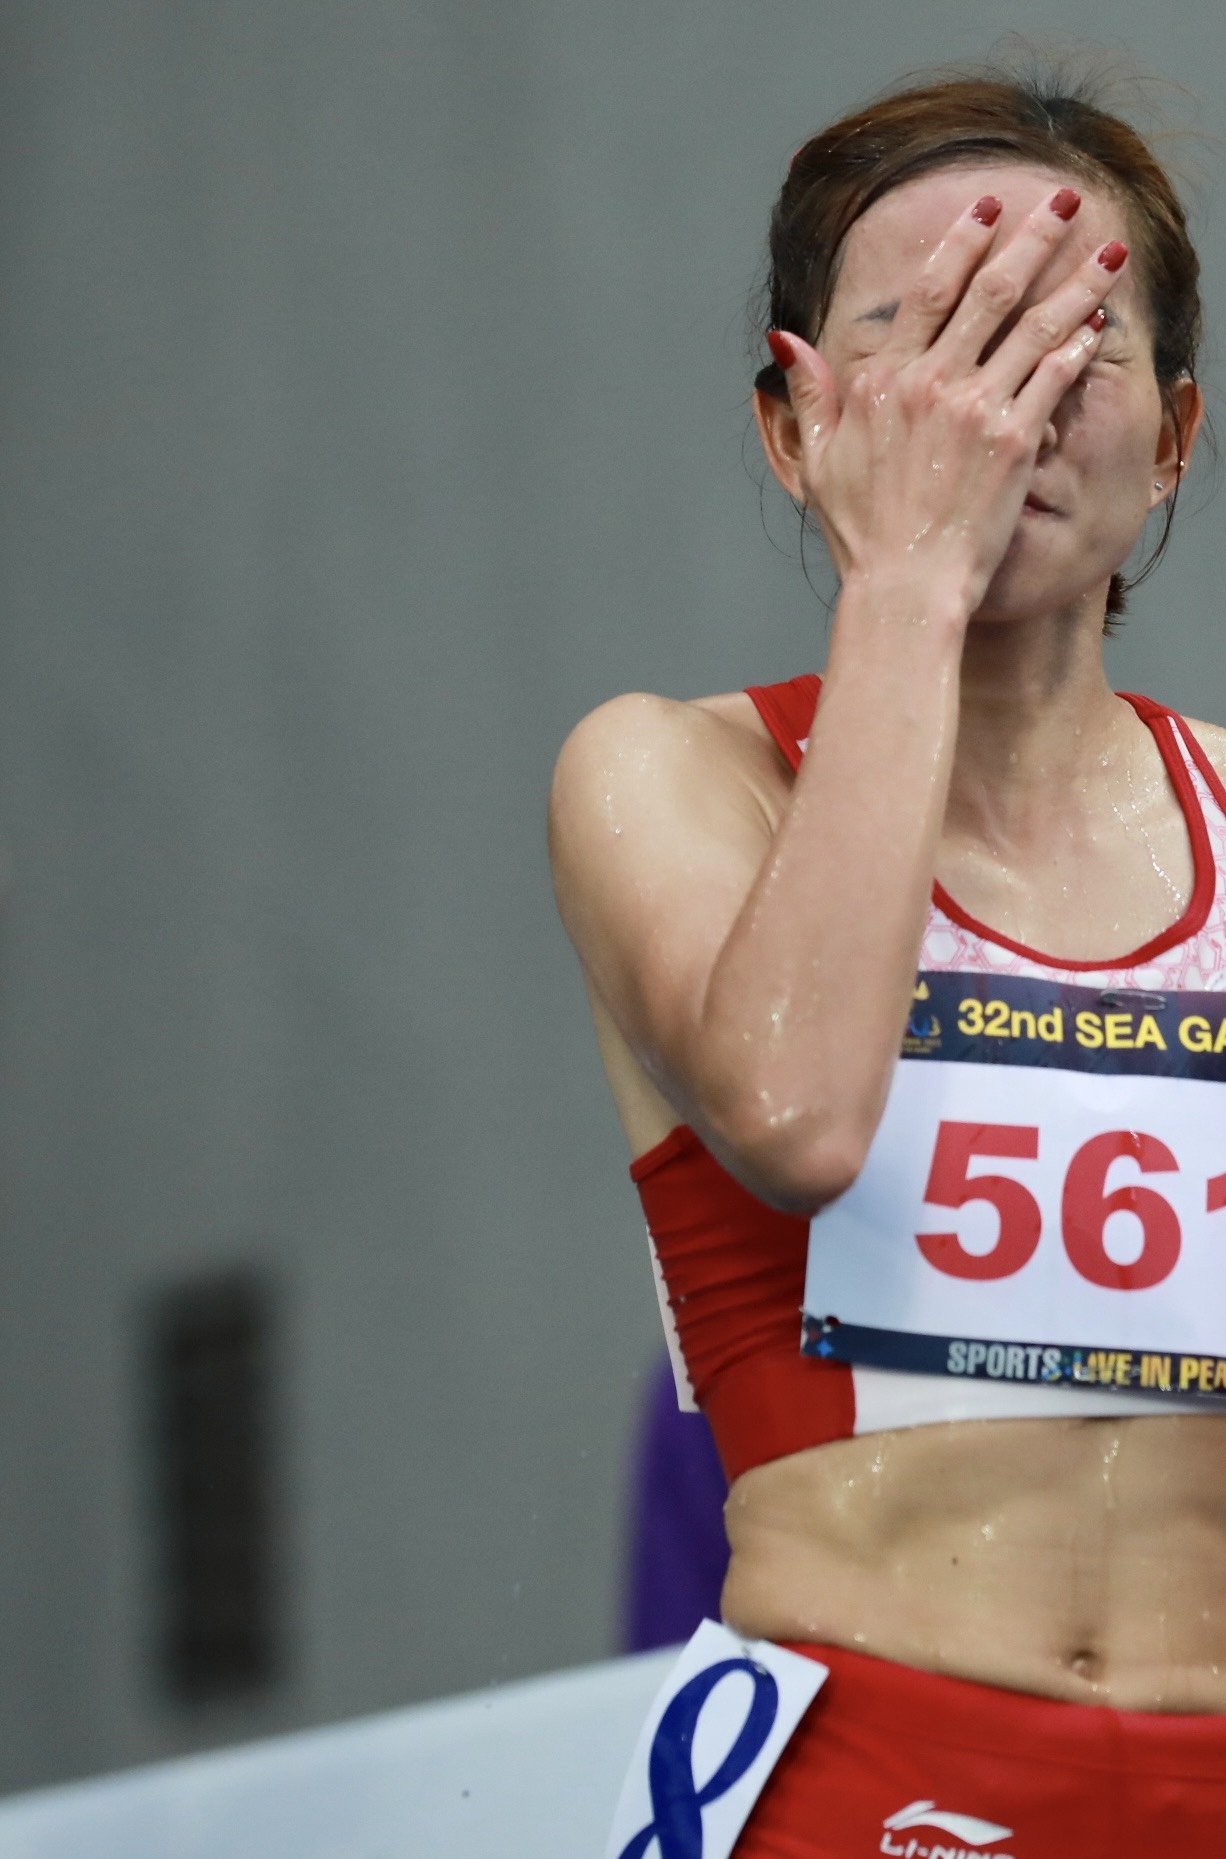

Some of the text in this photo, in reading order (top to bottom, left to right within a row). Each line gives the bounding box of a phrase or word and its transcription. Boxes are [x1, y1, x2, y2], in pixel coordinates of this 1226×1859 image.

[957, 998, 1063, 1043] 32nd
[1075, 1011, 1168, 1052] SEA
[1139, 1354, 1173, 1388] IN
